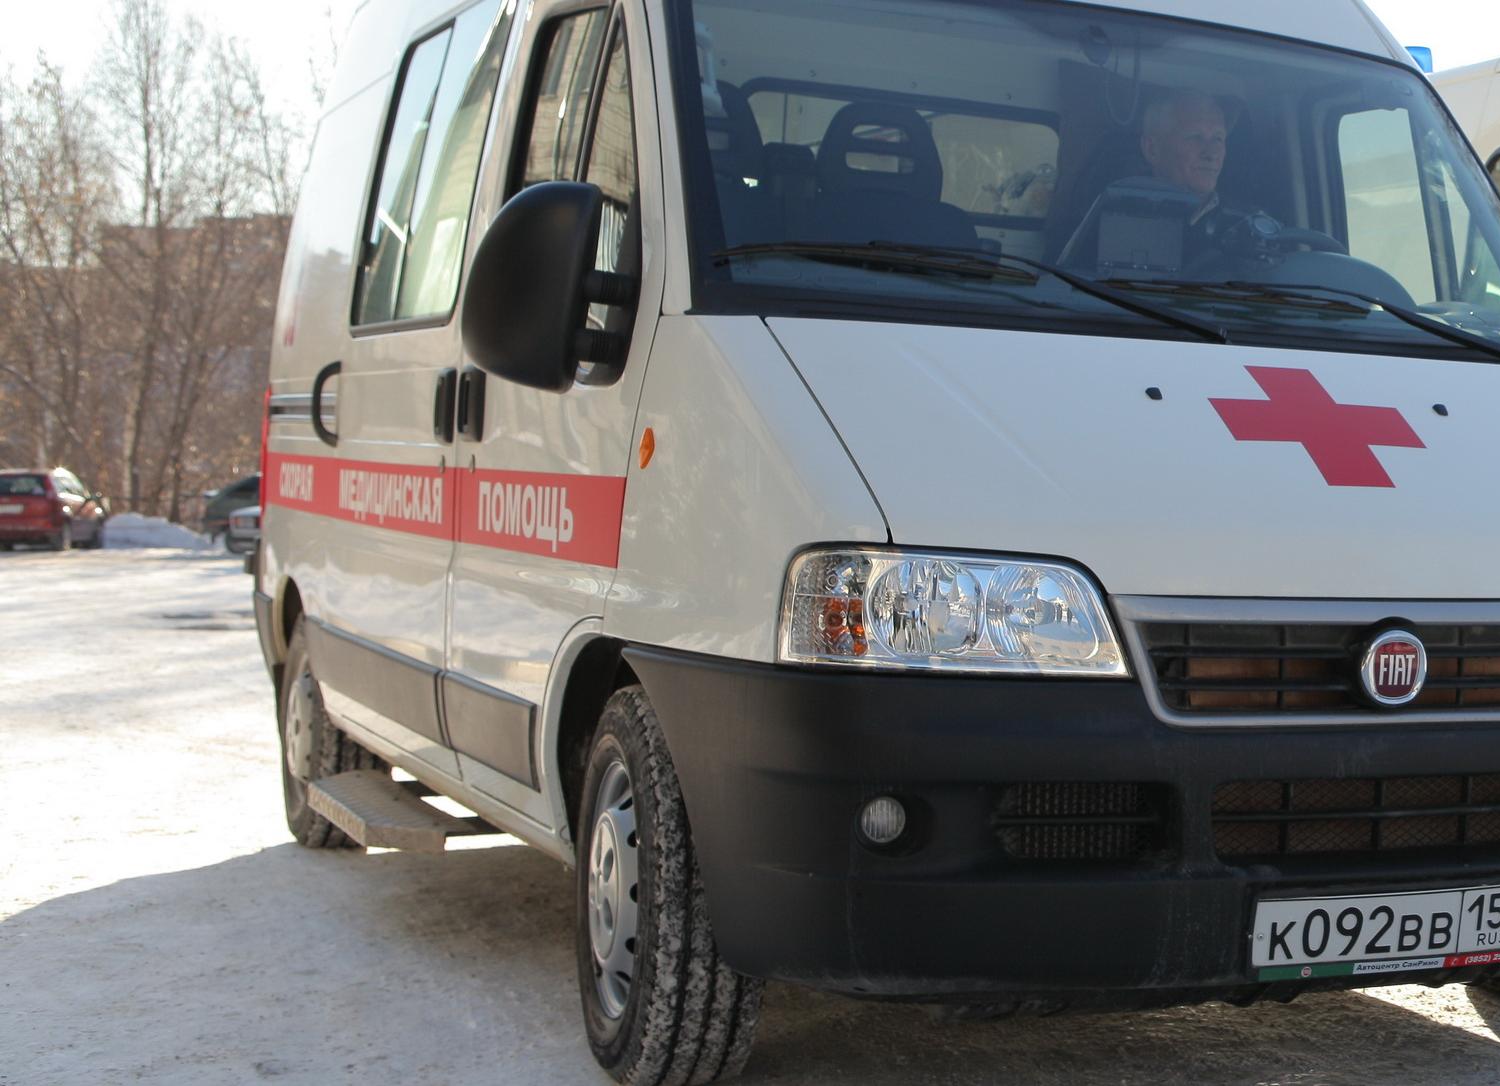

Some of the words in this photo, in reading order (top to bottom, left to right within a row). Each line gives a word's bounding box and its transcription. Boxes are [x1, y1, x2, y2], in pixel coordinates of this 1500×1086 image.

[339, 468, 443, 524] МЕДИЦИНСКАЯ
[478, 481, 574, 553] ПОМОЩЬ
[1378, 654, 1416, 686] FIAT
[1268, 905, 1453, 960] К092ВВ
